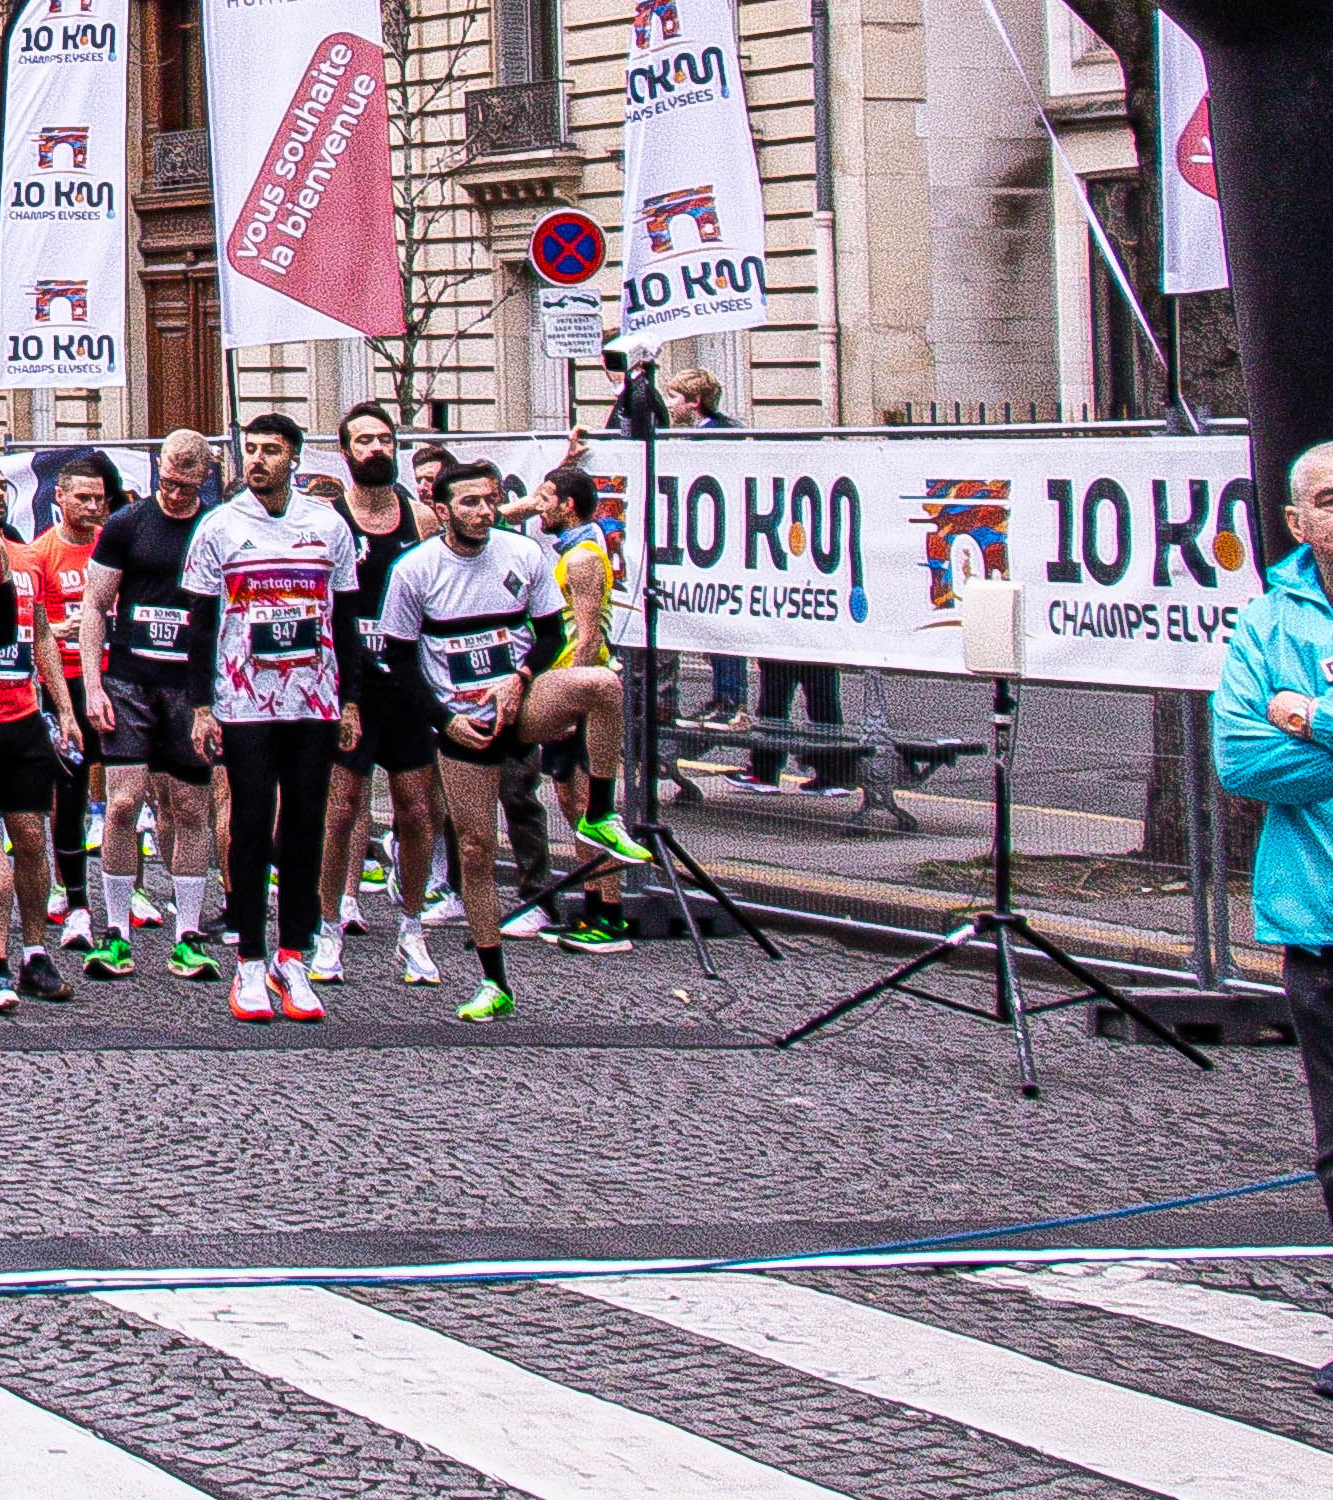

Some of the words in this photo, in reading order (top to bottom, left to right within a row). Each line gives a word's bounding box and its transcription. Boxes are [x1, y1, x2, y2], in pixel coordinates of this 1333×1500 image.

[20, 25, 54, 52] 10
[236, 182, 286, 260] vous
[275, 42, 353, 180] souhaite
[276, 72, 377, 240] bienvenue
[11, 181, 45, 208] 10
[260, 244, 295, 275] la
[624, 272, 671, 315] 10
[629, 305, 690, 332] CHAMPS
[7, 335, 44, 361] 10
[655, 474, 726, 570] 10
[1046, 477, 1132, 588] 10
[748, 577, 839, 622] ELYSÉES
[149, 621, 180, 641] 9157
[271, 621, 299, 641] 947
[1049, 600, 1161, 642] CHAMPS
[1167, 603, 1238, 644] ELYS
[469, 648, 491, 669] 811
